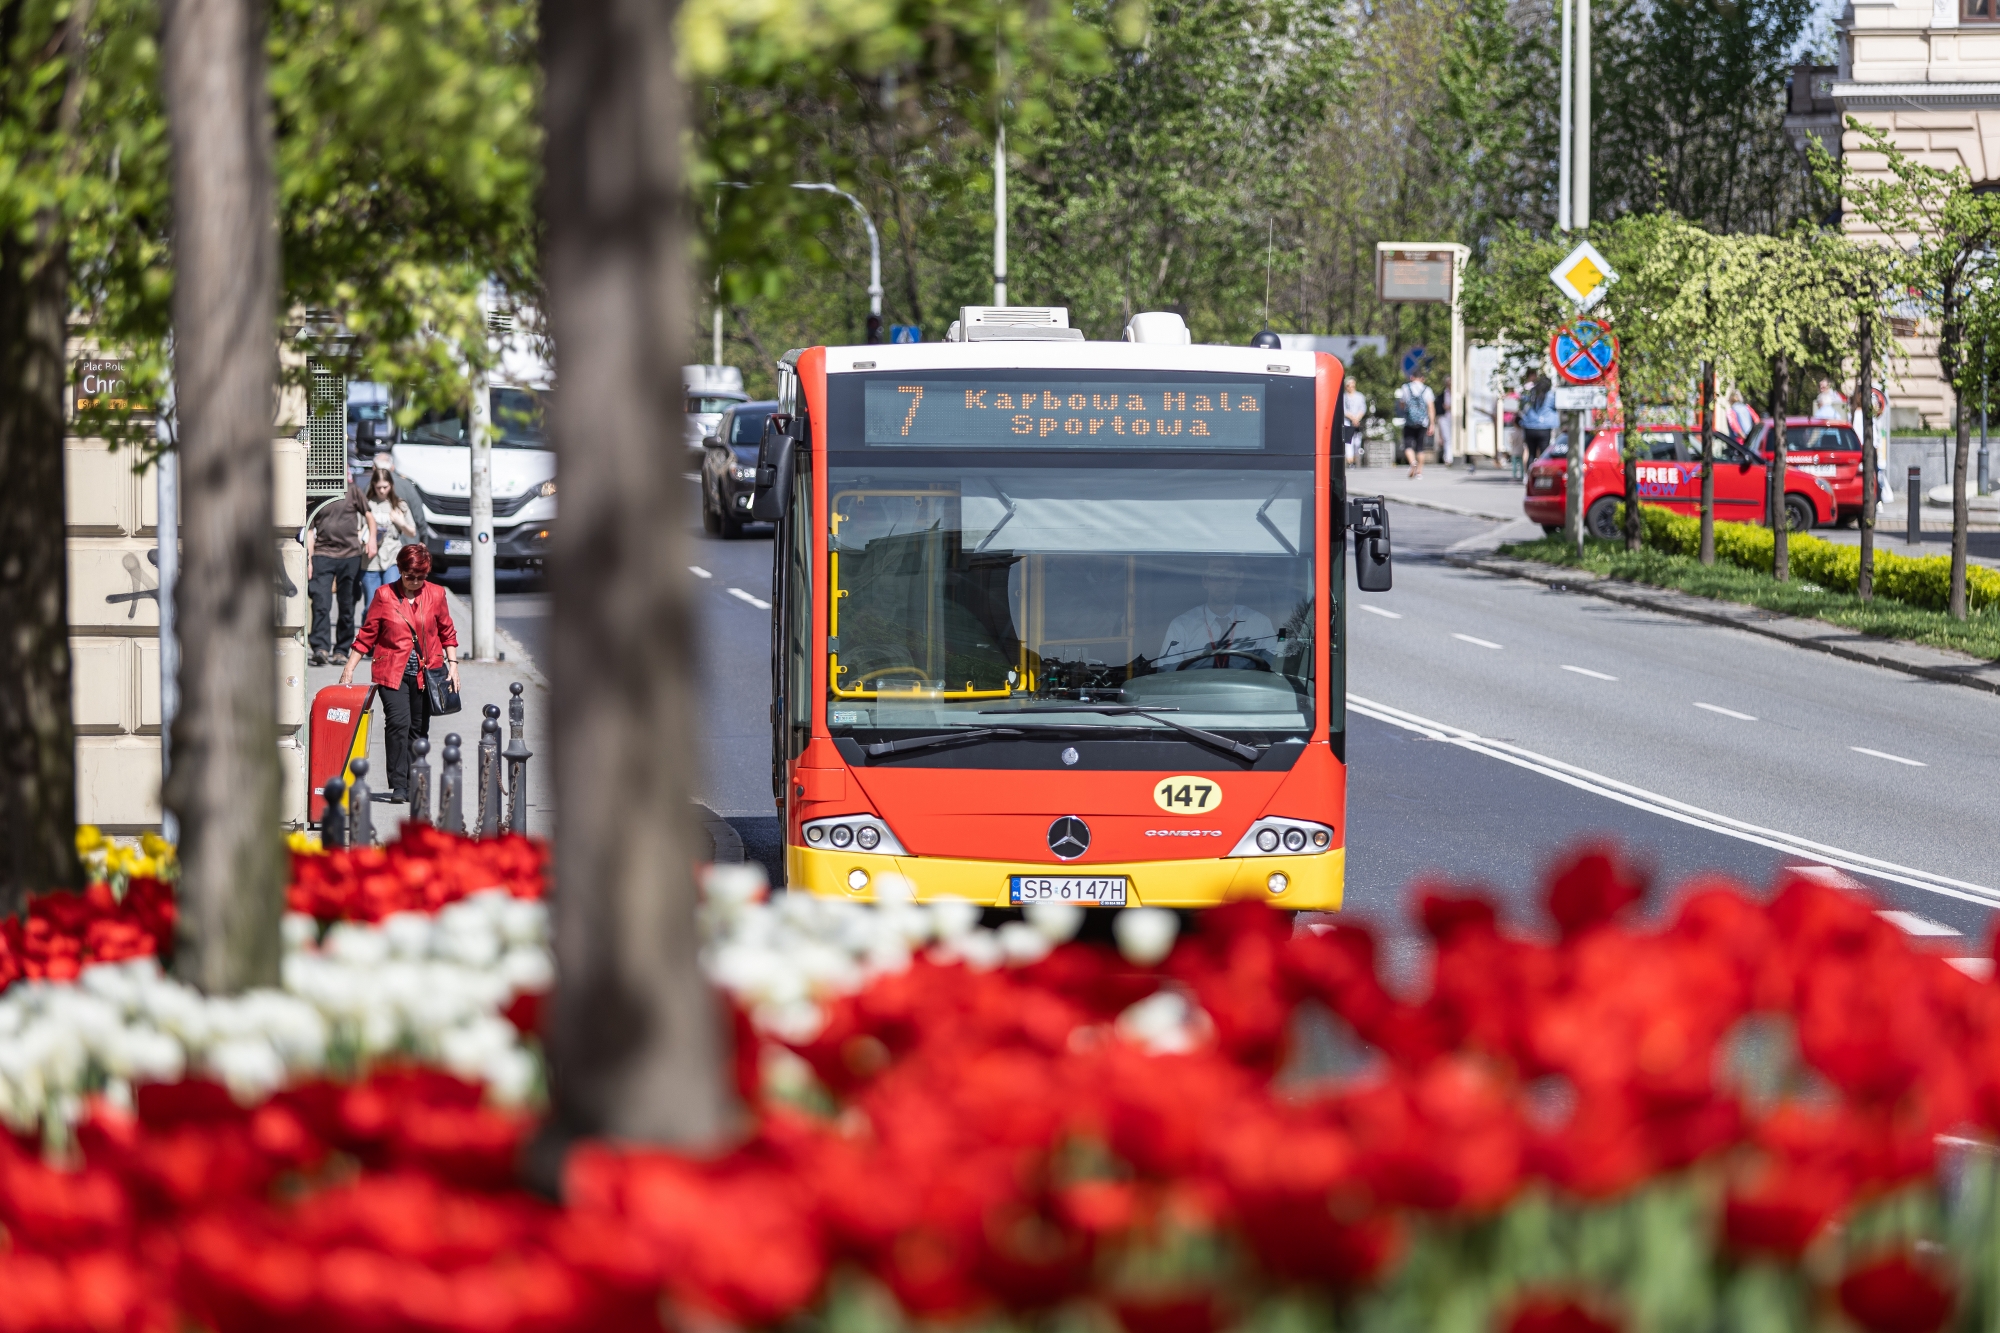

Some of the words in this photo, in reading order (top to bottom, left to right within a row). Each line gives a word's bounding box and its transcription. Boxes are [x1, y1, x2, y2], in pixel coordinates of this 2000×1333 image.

[83, 362, 103, 371] Plac
[965, 389, 1147, 411] Karbowa
[1163, 391, 1261, 412] Hala
[898, 386, 924, 437] 7
[1011, 414, 1211, 438] Sportowa
[1635, 466, 1679, 484] FREE
[1635, 482, 1678, 496] NOW
[1160, 784, 1213, 808] 147
[1144, 829, 1223, 837] CONECTO
[1024, 879, 1053, 899] SB
[1061, 880, 1123, 899] 6147H
